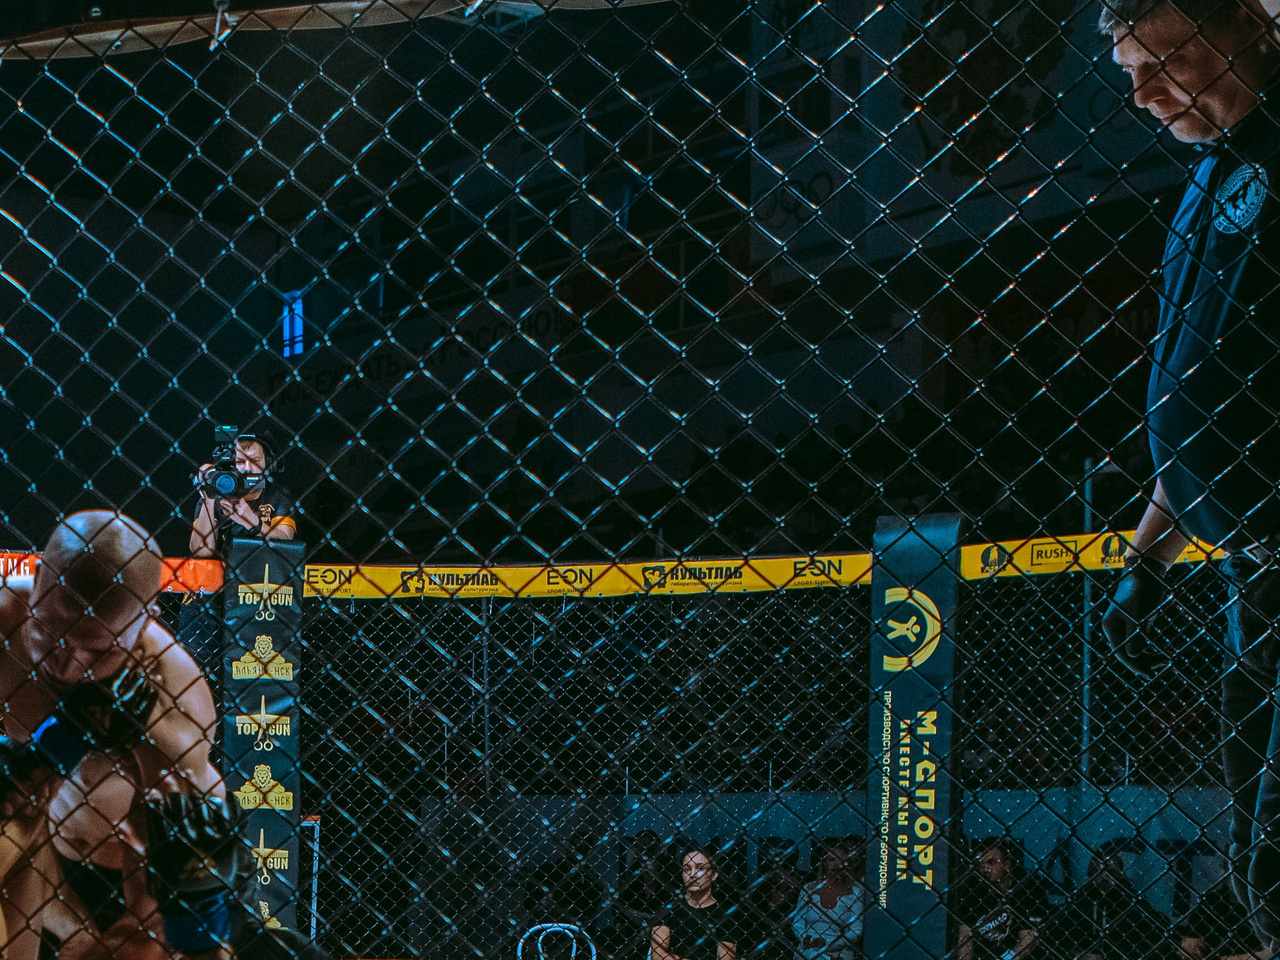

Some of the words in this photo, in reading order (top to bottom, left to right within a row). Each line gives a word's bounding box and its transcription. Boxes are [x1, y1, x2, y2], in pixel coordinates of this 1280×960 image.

[238, 592, 261, 605] TOP
[270, 593, 293, 606] GUN
[236, 723, 259, 736] TOP
[268, 724, 291, 736] GUN
[911, 710, 938, 891] М-СПОРТ
[266, 857, 289, 870] GUN
